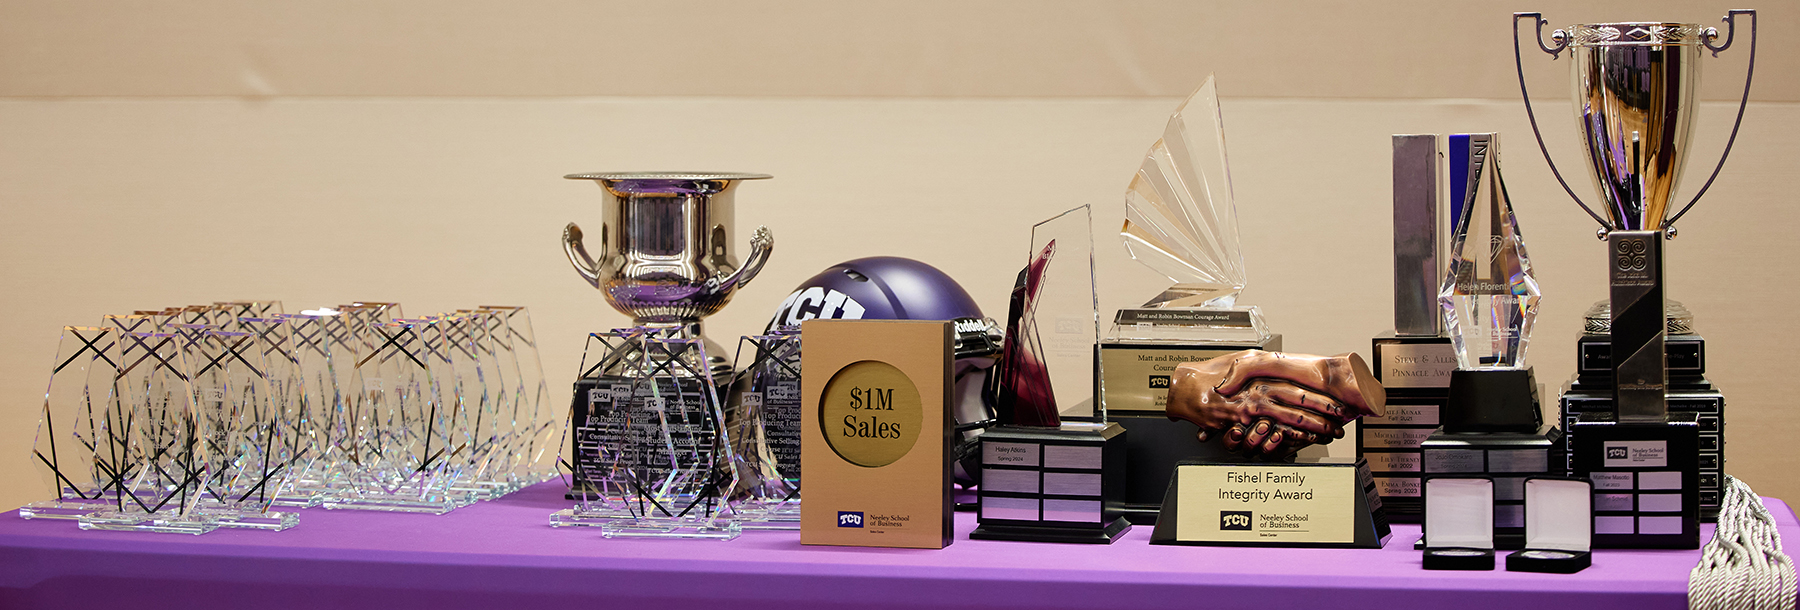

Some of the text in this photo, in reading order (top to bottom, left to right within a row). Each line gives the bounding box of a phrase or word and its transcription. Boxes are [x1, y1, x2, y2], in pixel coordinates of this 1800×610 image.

[1457, 282, 1480, 291] Helen
[769, 286, 866, 331] TCU
[1421, 355, 1429, 364] &
[1151, 377, 1169, 387] TCU
[592, 392, 609, 400] TCU
[769, 388, 785, 397] TCU
[744, 395, 761, 403] TCU
[850, 386, 894, 411] $1M
[764, 412, 777, 420] Top
[739, 419, 751, 427] Top
[752, 419, 785, 428] Producing
[843, 414, 901, 439] Sales
[995, 446, 1010, 454] Haley
[1609, 448, 1626, 457] TCU
[1227, 472, 1306, 486] Fishel Family
[1218, 488, 1313, 502] Integrity Award
[840, 514, 862, 525] TCU
[1223, 514, 1250, 527] TCU
[1260, 514, 1284, 522] Neeley
